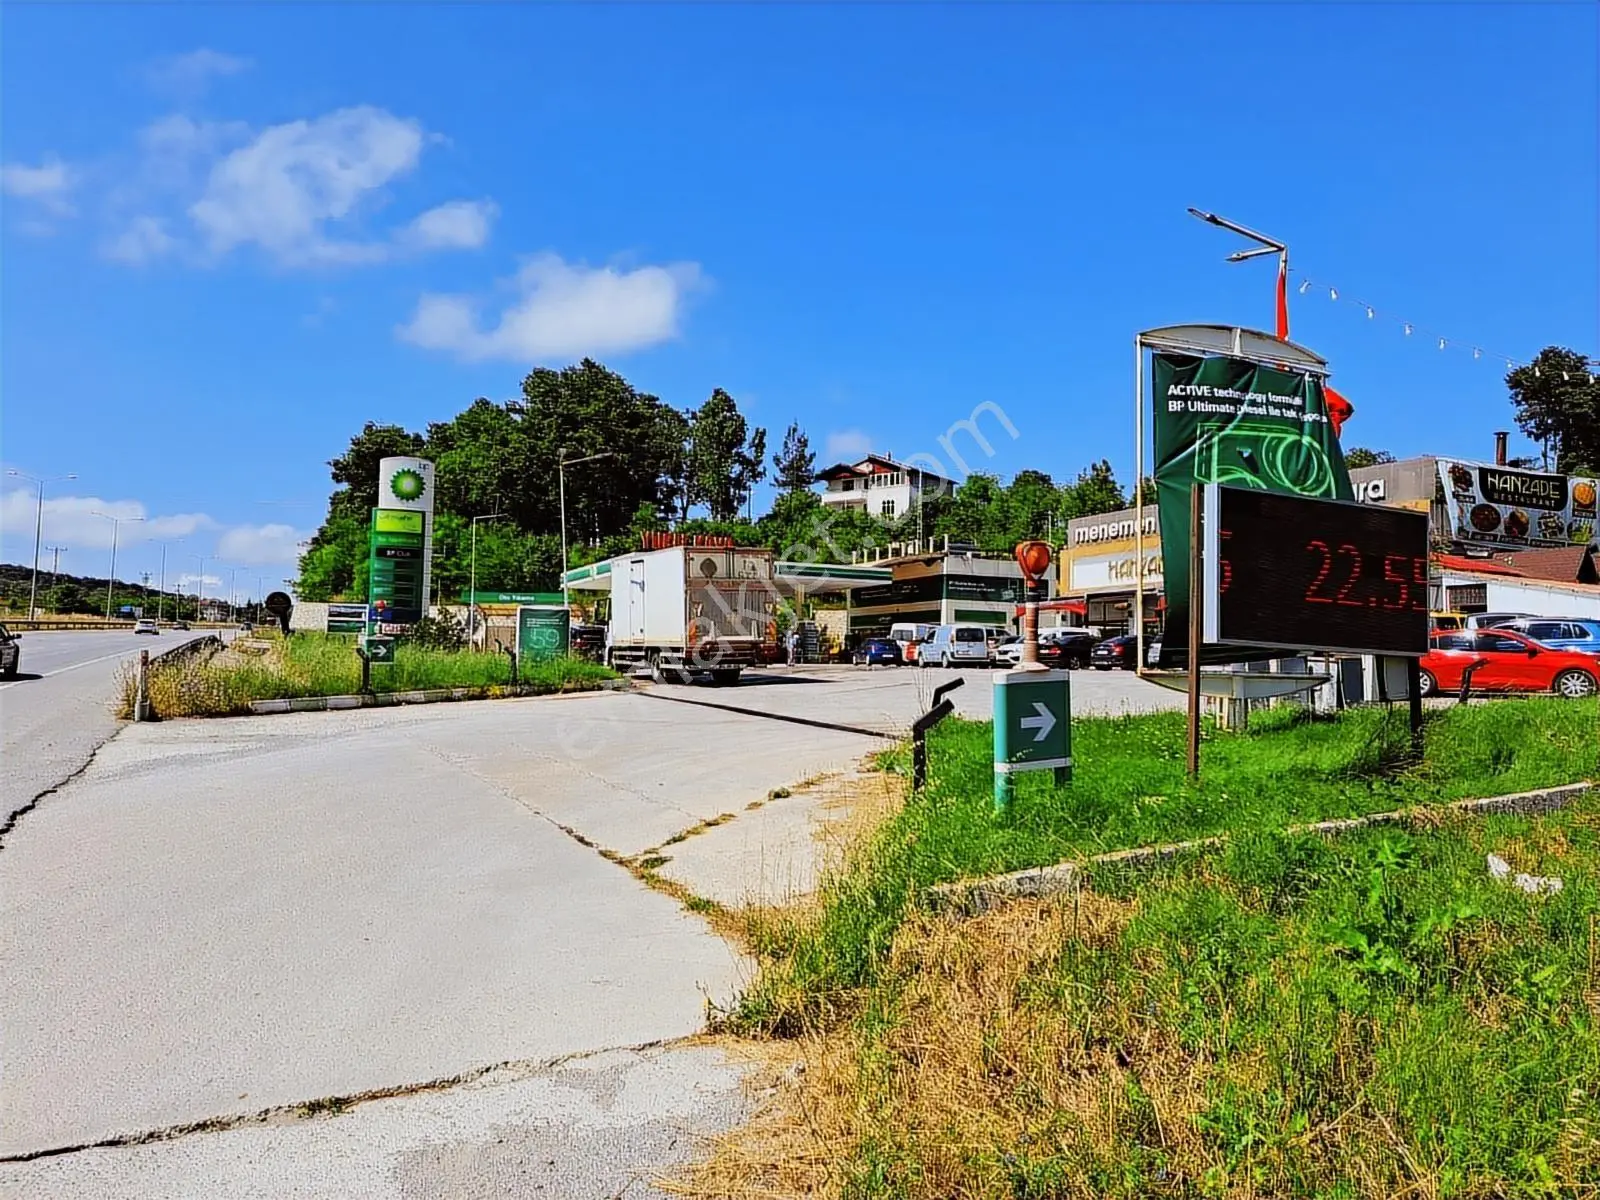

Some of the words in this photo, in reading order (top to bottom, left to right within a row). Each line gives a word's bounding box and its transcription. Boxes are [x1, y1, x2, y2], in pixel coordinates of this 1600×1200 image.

[1167, 384, 1212, 397] ACTIVE
[1168, 400, 1185, 412] BP
[1187, 401, 1236, 414] Ultimate
[1487, 472, 1561, 499] HANZADE
[1108, 556, 1164, 581] HANZA
[529, 626, 561, 649] 59
